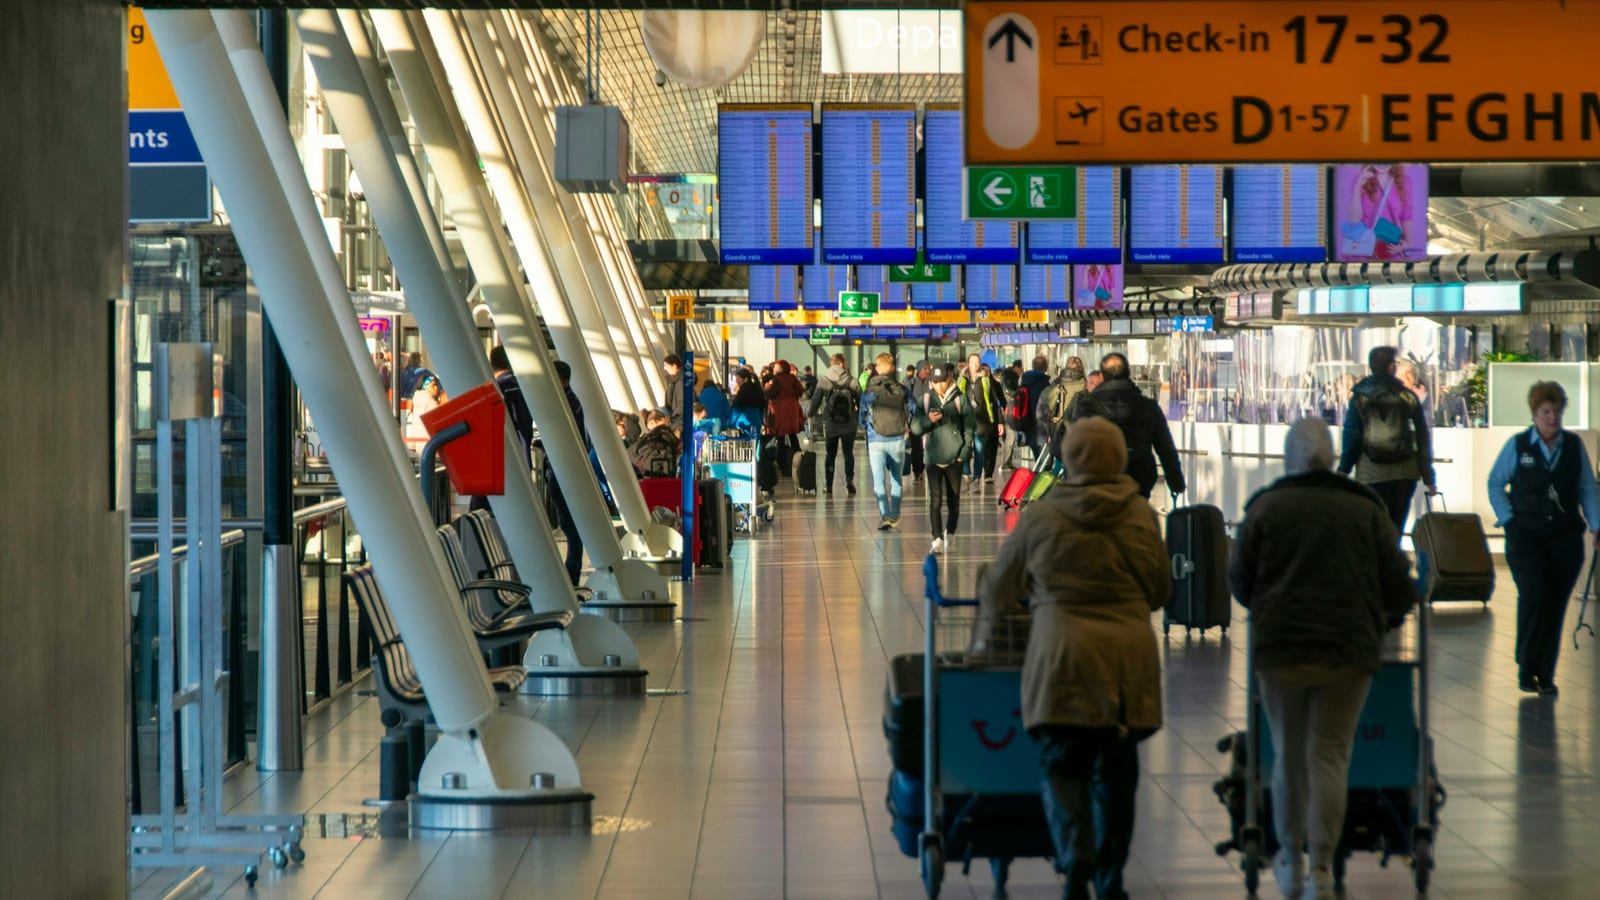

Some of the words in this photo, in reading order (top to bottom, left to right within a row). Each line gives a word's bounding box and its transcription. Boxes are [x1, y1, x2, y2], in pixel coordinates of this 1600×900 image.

[1118, 23, 1270, 53] Check-in
[1283, 14, 1451, 65] 17-32
[1117, 104, 1219, 134] Gates
